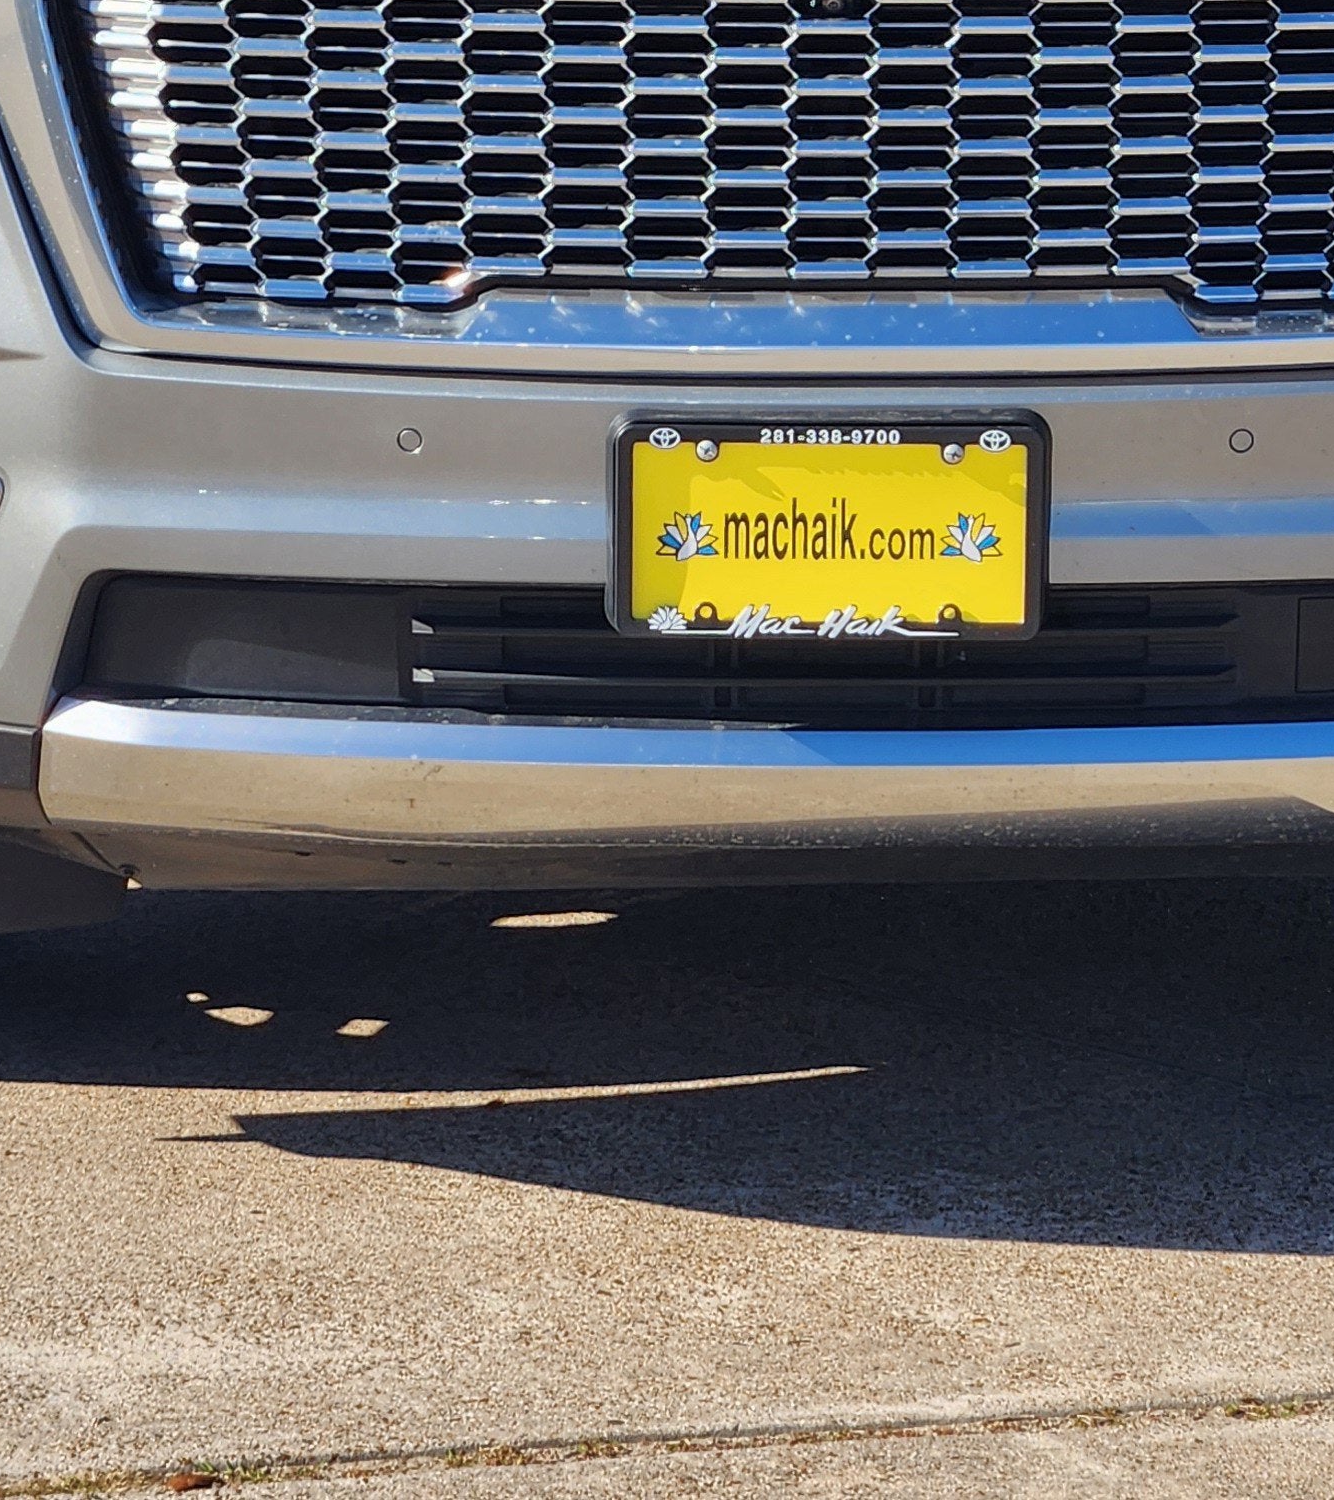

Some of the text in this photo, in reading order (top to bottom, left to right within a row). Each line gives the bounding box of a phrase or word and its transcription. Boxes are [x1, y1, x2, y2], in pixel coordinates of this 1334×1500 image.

[760, 428, 901, 446] 281-338-9700
[723, 497, 935, 560] machaik.com
[725, 603, 909, 638] Mac Haik
